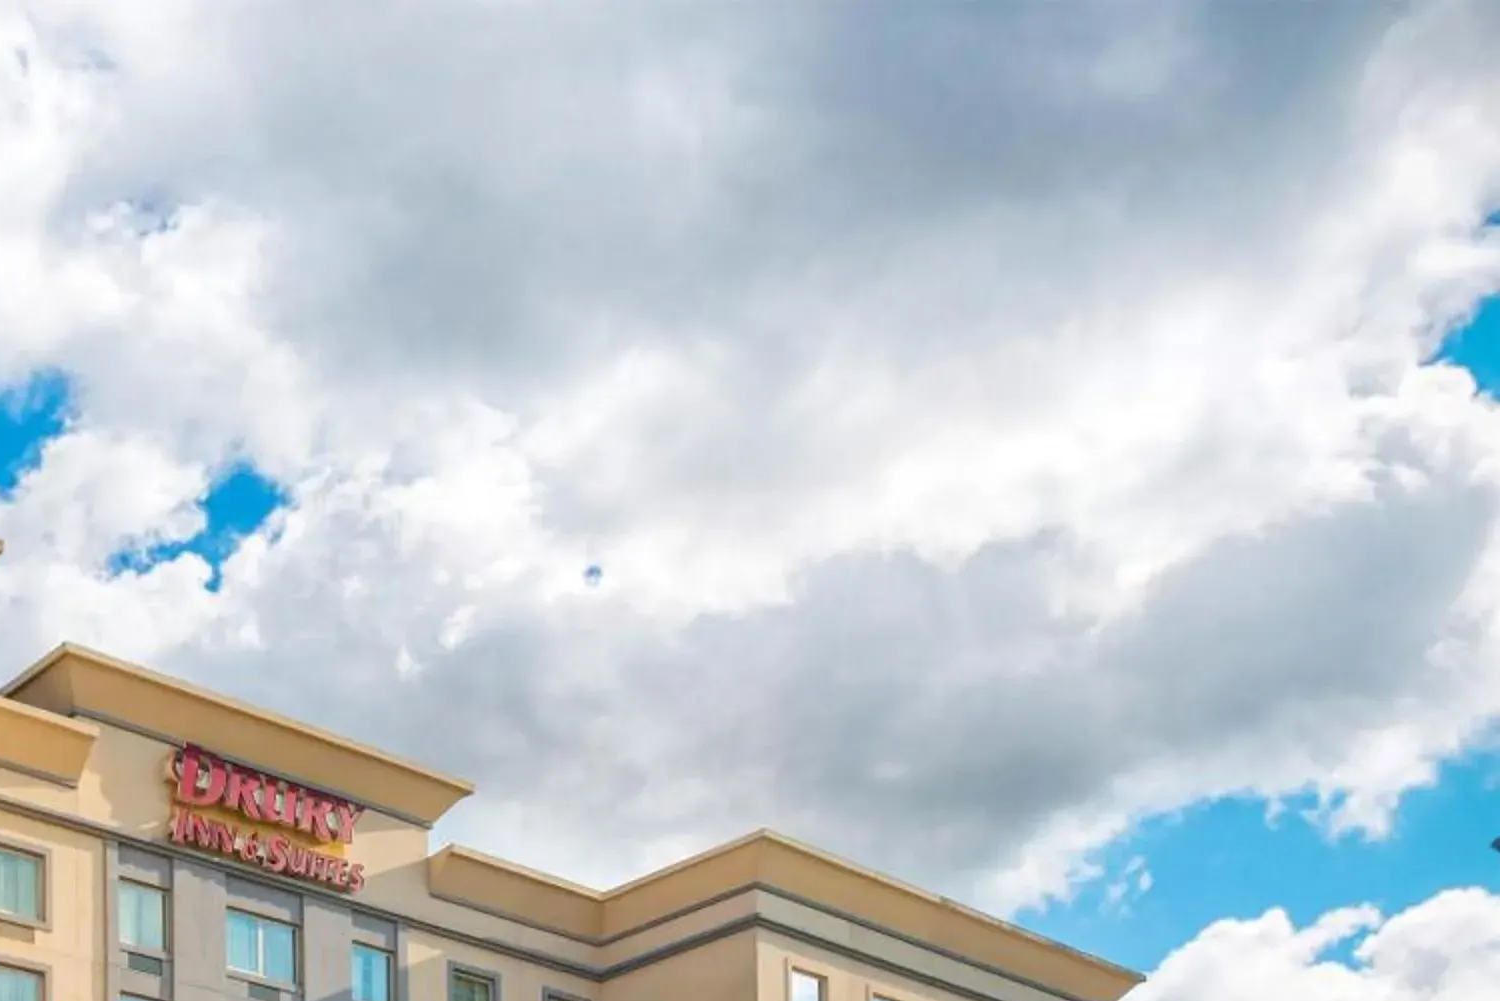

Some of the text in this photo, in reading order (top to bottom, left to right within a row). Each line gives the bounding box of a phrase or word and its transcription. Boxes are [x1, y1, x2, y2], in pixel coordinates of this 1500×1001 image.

[174, 741, 366, 845] DRURY
[171, 807, 365, 894] INN & SUITES
